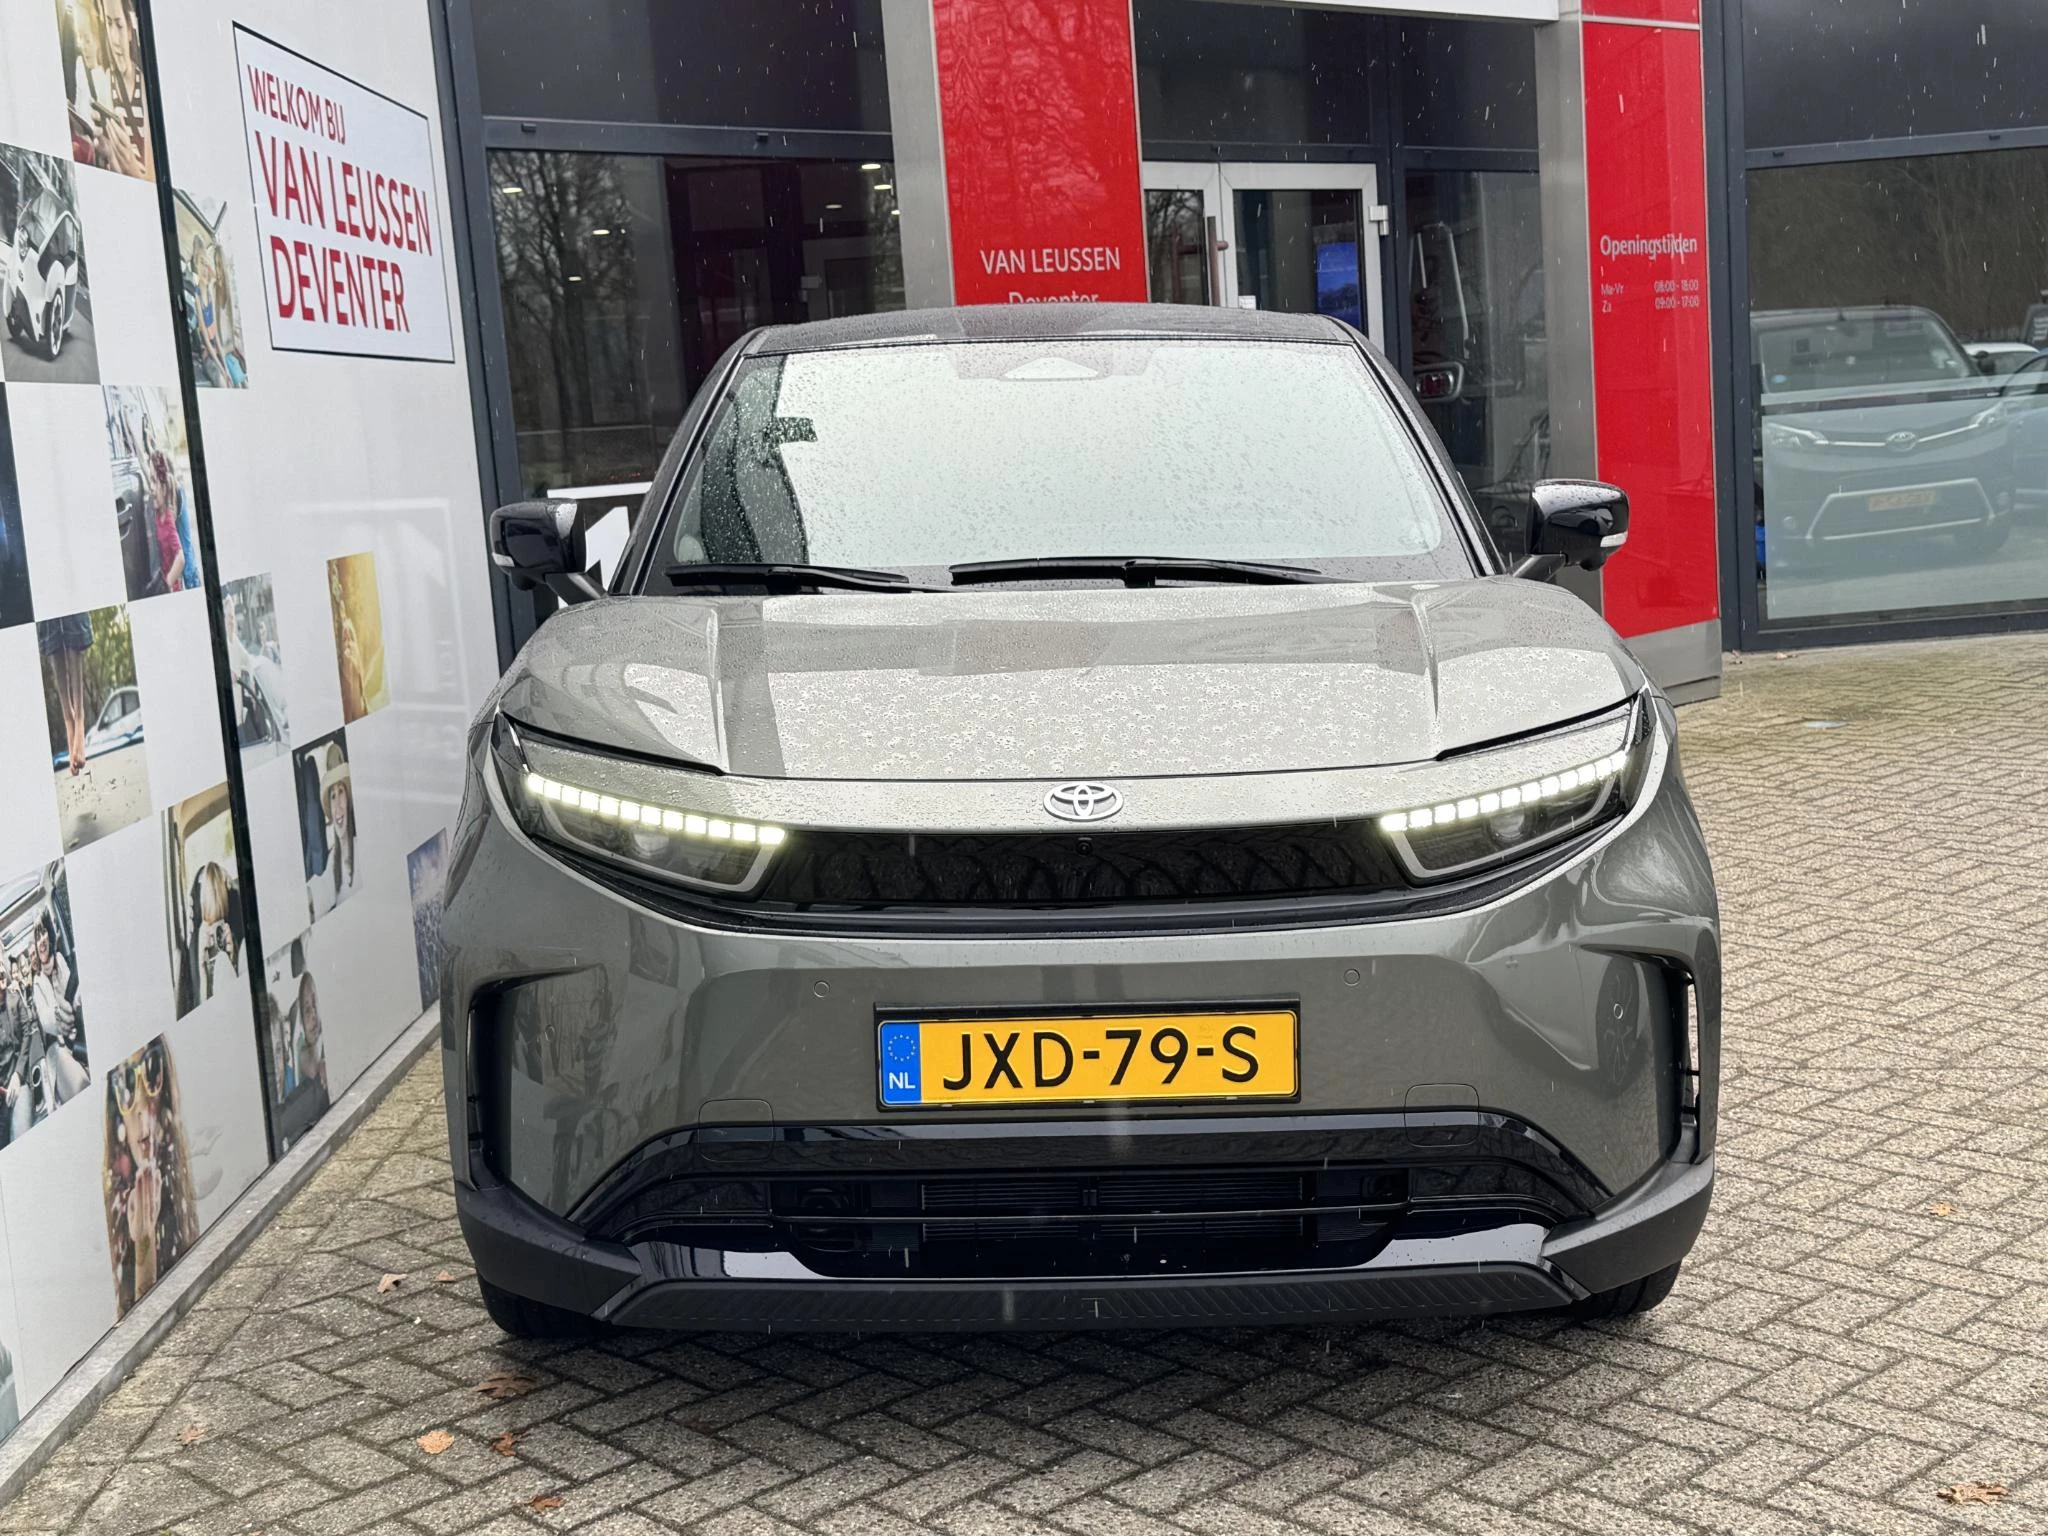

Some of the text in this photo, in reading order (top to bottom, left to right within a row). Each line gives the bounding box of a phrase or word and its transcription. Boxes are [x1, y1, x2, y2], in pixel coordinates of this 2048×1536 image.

[247, 64, 346, 145] WELKOM BIJ
[255, 130, 432, 256] VAN LEUSSEN
[980, 247, 1121, 275] VAN LEUSSEN
[1600, 233, 1698, 262] Openingstijden
[270, 235, 410, 332] DEVENTER
[1602, 300, 1612, 313] Za
[888, 1072, 916, 1090] NL
[943, 1025, 1259, 1091] JXD-79-S
